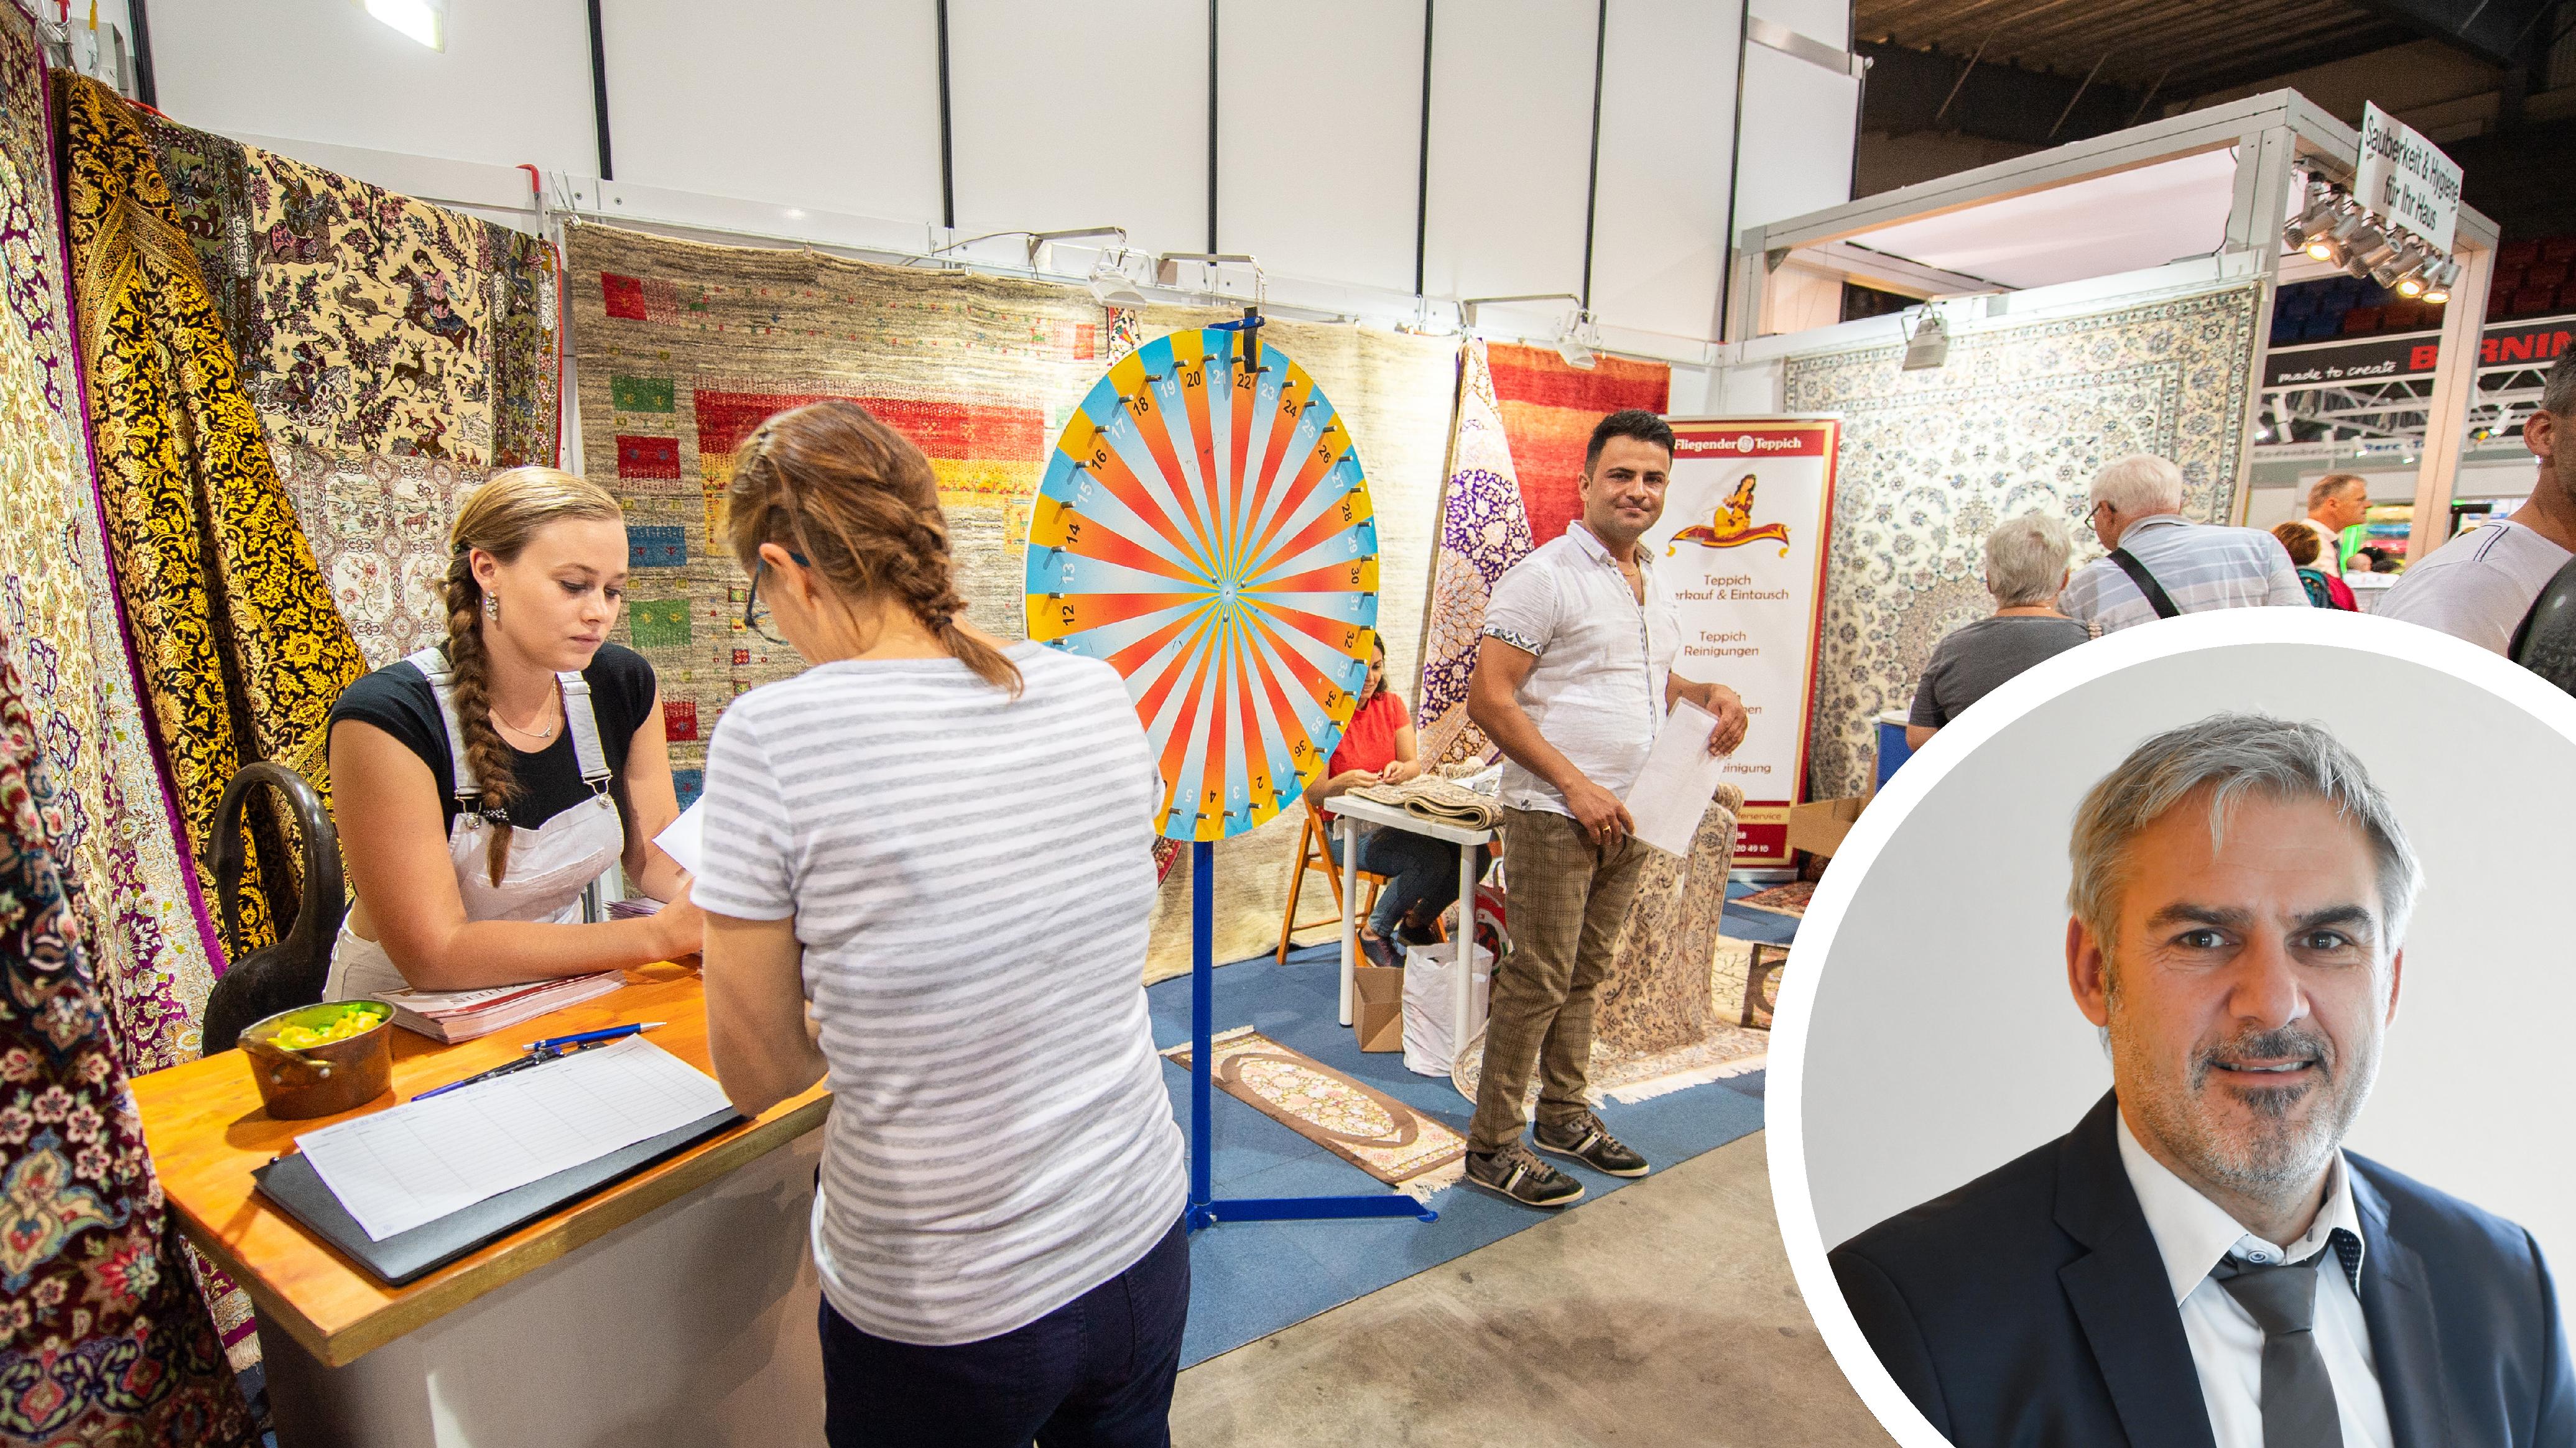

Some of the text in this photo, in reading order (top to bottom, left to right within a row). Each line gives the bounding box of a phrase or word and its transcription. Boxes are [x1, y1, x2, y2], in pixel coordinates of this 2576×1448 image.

[2366, 115, 2458, 203] Sauberkeit & Hygiene
[2384, 175, 2437, 230] für Ihr Haus
[1187, 371, 1200, 387] 20
[1213, 370, 1226, 384] 21
[2278, 360, 2397, 384] made to create
[1161, 380, 1175, 397] 19
[1238, 374, 1250, 389] 22
[1263, 383, 1274, 400] 23
[1134, 397, 1148, 416] 18
[1284, 400, 1296, 418] 24
[1112, 418, 1125, 438] 17
[1302, 420, 1315, 438] 25
[1674, 436, 1801, 452] Fliegender Teppich
[1092, 450, 1106, 470] 16
[1318, 445, 1331, 463] 26
[1332, 472, 1343, 488] 27
[1077, 482, 1092, 502] 15
[1342, 503, 1351, 521] 28
[1067, 524, 1080, 544] 14
[1348, 537, 1357, 553] 29
[1062, 563, 1075, 583] 13
[1351, 568, 1359, 584] 30
[1704, 574, 1751, 587] Teppich
[1675, 589, 1789, 601] erkauf & Eintausch
[1350, 596, 1358, 611] 31
[1063, 605, 1074, 625] 12
[1345, 632, 1353, 648] 32
[1700, 630, 1746, 643] Teppich
[1684, 645, 1759, 658] Reinigungen
[1338, 662, 1347, 678] 33
[1325, 691, 1336, 708] 34
[1312, 716, 1323, 734] 35
[1295, 740, 1306, 757] 36
[1279, 763, 1285, 773] 1
[1723, 763, 1771, 774] einigung
[1257, 777, 1263, 788] 2
[1185, 789, 1193, 802] 5
[1210, 791, 1216, 803] 4
[1233, 786, 1239, 799] 3
